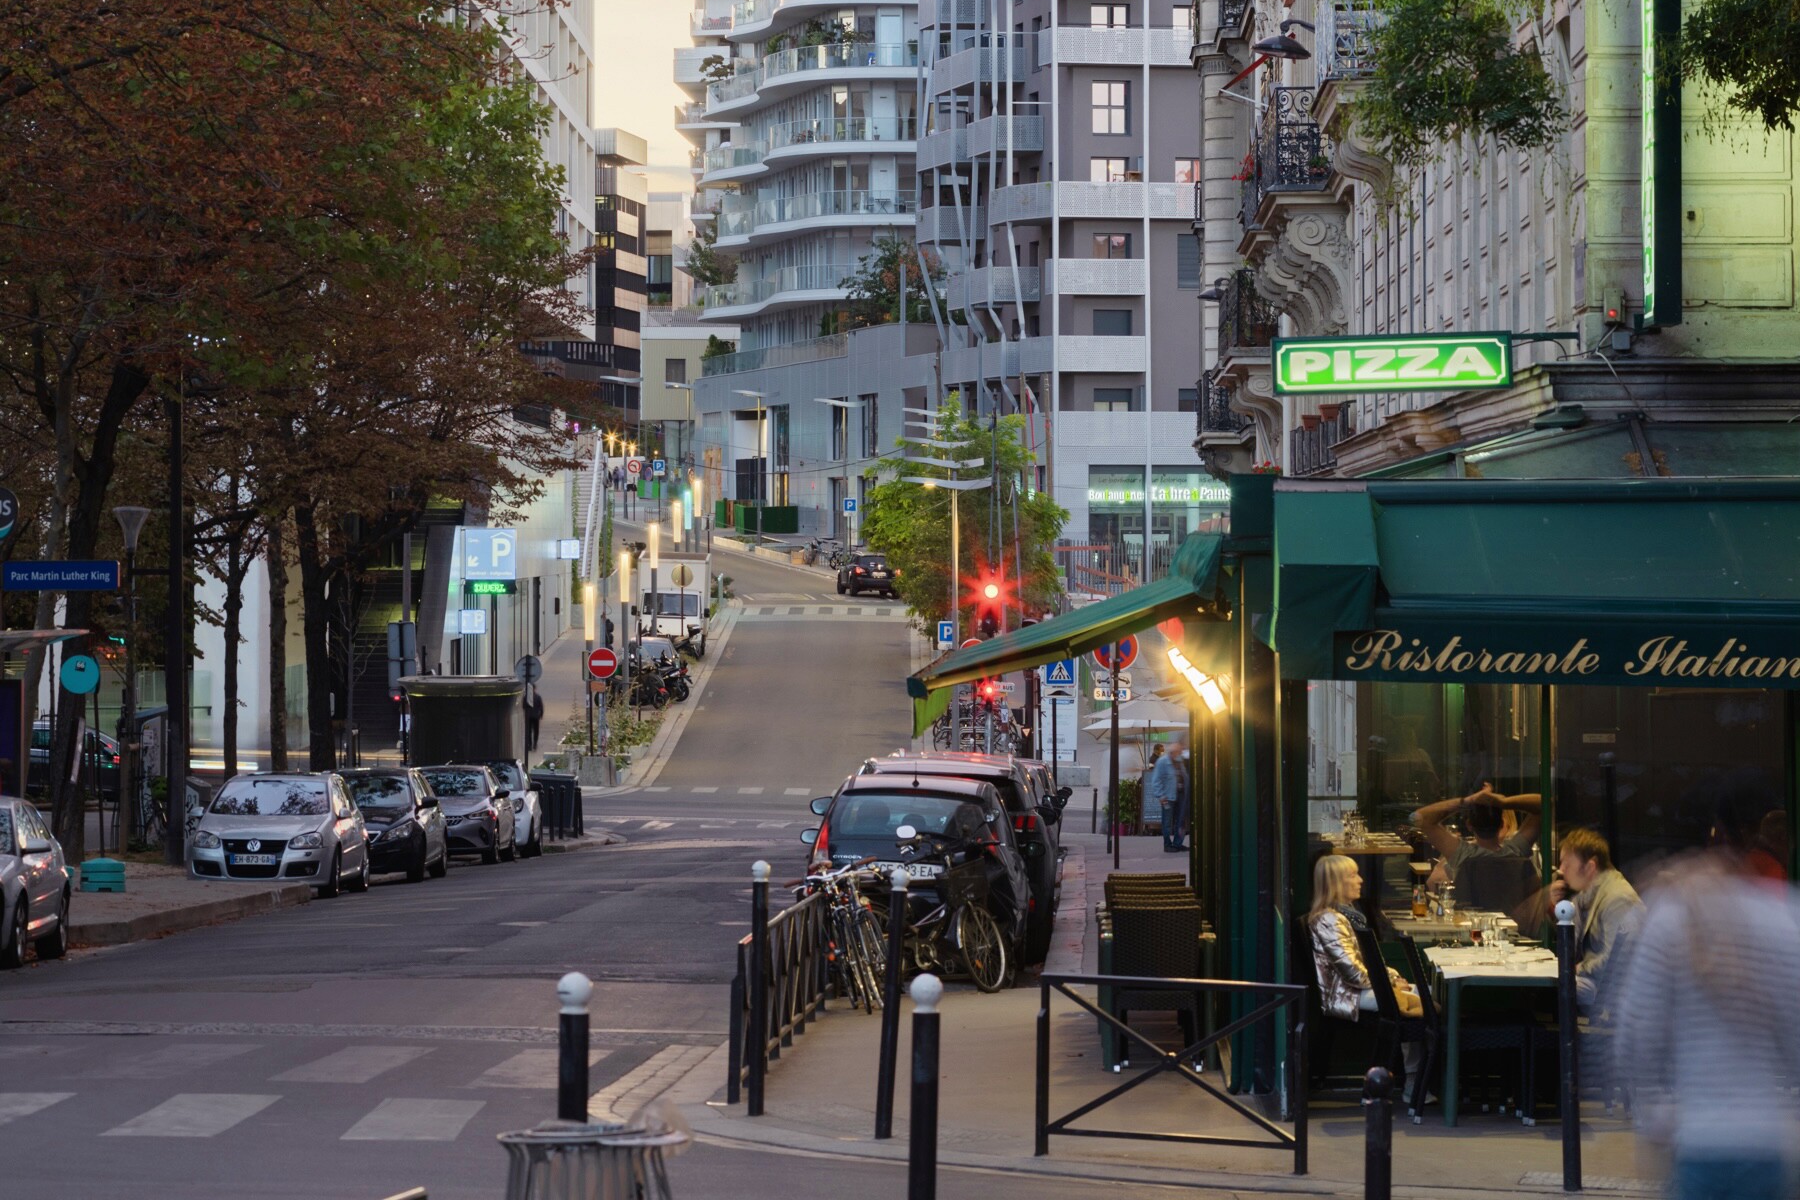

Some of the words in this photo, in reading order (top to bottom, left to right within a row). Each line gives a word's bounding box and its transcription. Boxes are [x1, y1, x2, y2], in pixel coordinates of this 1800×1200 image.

[1290, 346, 1497, 382] PIZZA
[1200, 486, 1231, 501] Pains
[492, 538, 511, 567] P
[11, 571, 28, 580] Parc
[31, 571, 59, 580] Martin
[62, 571, 88, 580] Luther
[91, 571, 110, 582] King
[943, 626, 953, 639] P
[1345, 630, 1600, 674] Ristorante
